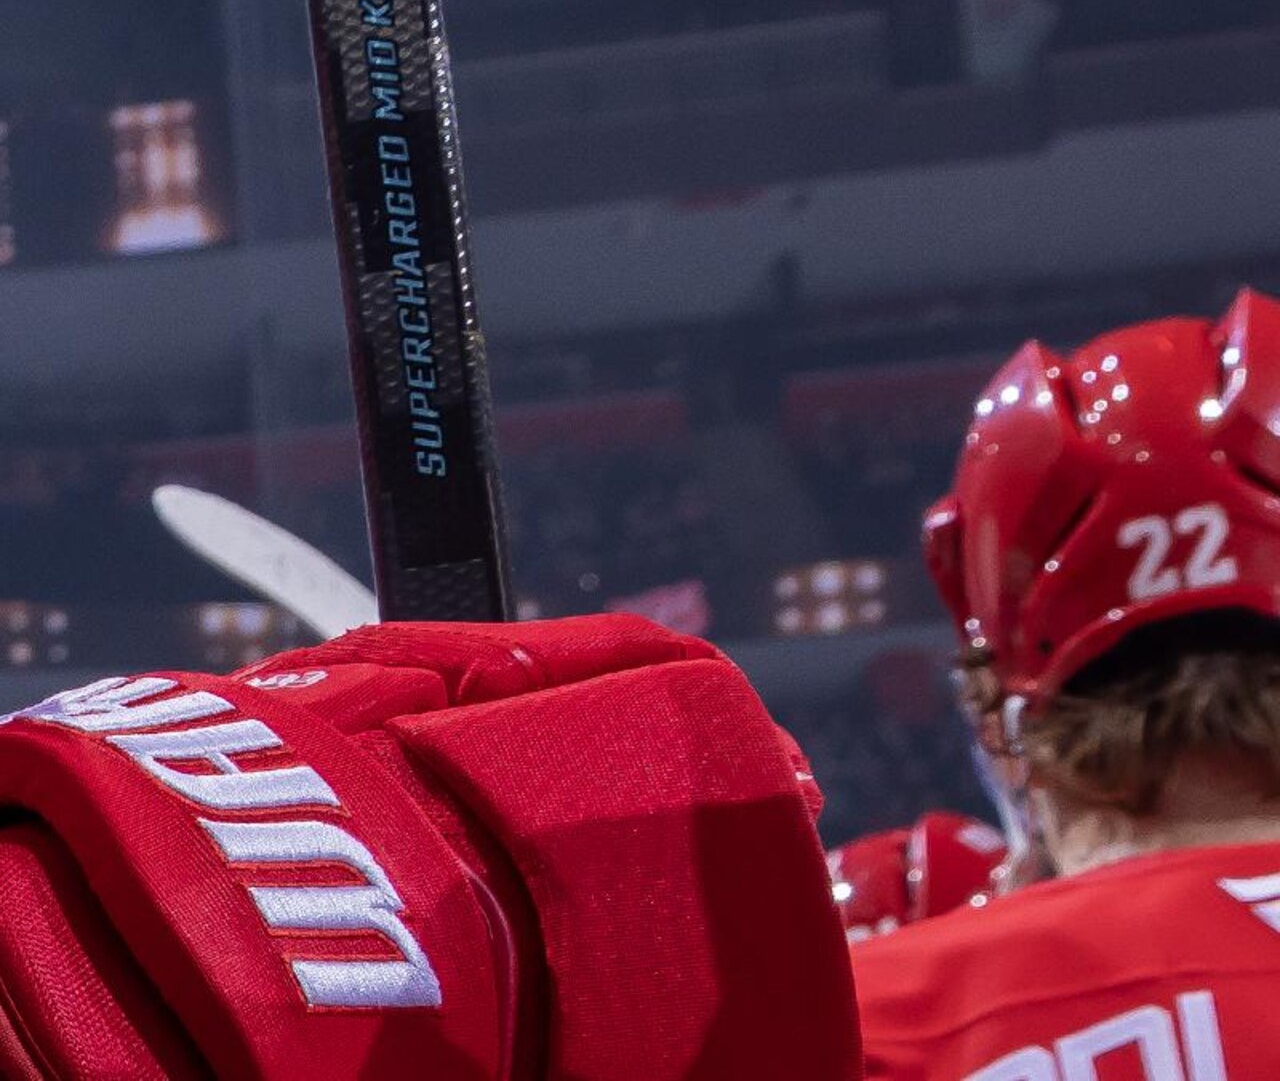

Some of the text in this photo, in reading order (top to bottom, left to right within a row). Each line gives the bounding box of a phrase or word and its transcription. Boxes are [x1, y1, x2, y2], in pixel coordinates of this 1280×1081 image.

[368, 38, 404, 120] MID
[377, 135, 446, 477] SUPERCHARGED
[1116, 503, 1238, 600] 22
